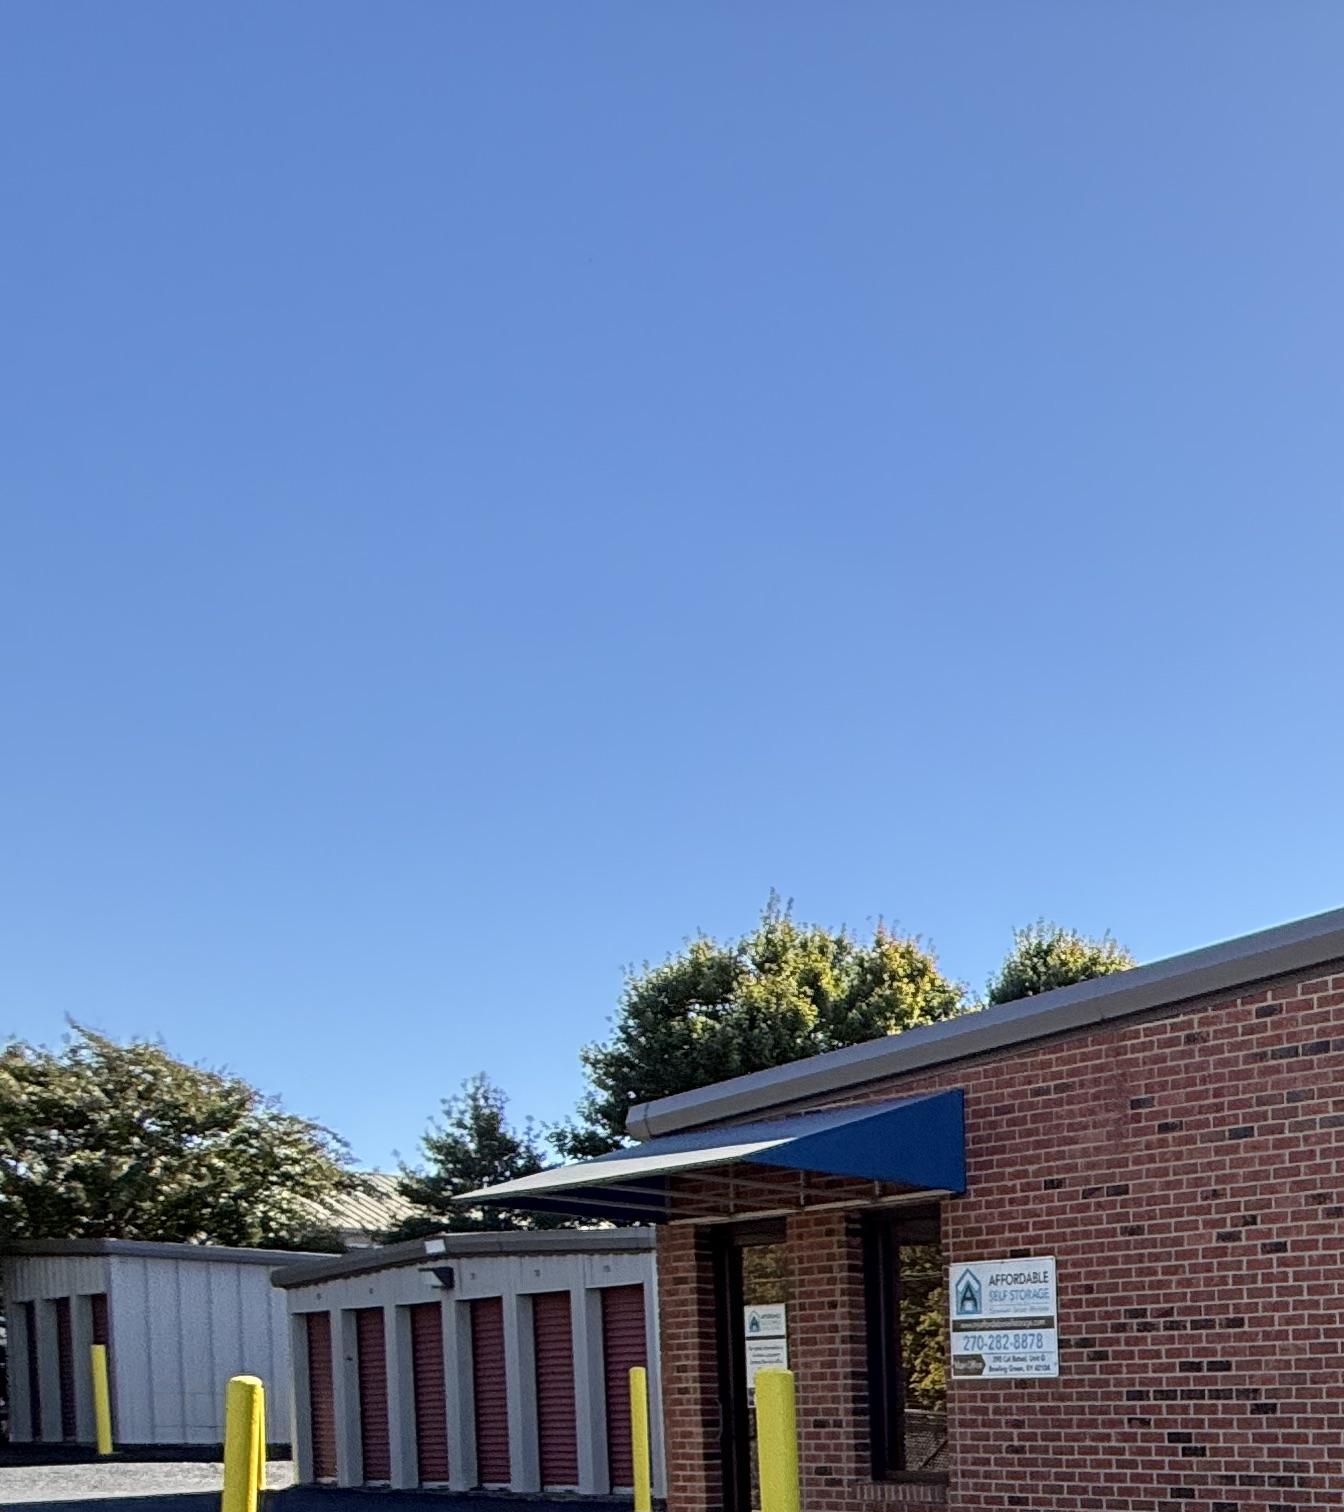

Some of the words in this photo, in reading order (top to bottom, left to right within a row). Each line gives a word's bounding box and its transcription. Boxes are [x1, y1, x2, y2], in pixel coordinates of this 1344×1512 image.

[988, 1271, 1049, 1286] AFFORDABLE
[989, 1290, 1008, 1302] SELF
[1010, 1288, 1050, 1301] STORAGE
[963, 1333, 1043, 1351] 270-282-8878
